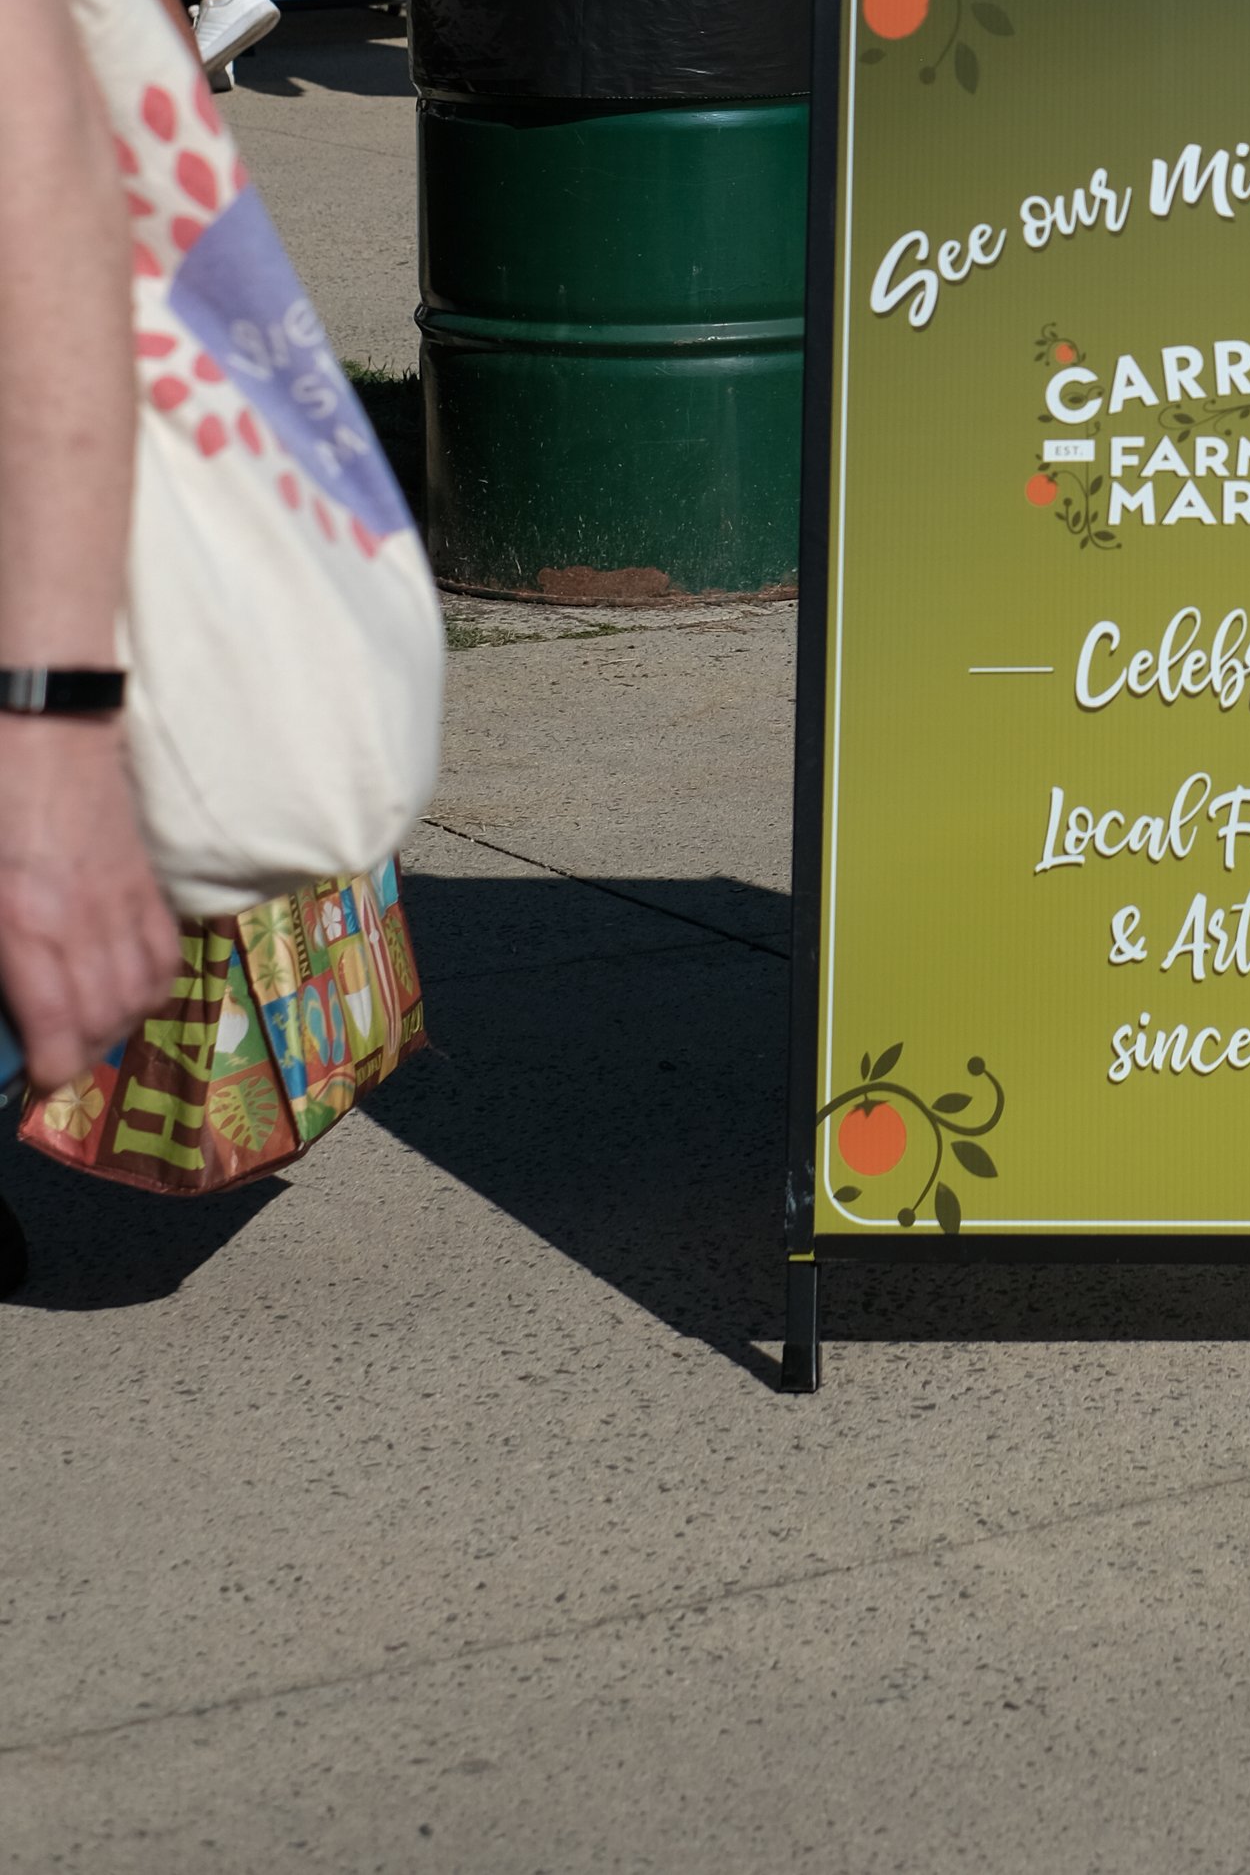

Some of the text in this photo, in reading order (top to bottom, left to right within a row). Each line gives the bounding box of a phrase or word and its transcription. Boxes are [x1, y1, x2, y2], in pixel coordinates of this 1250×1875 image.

[869, 228, 1006, 329] See
[1020, 166, 1131, 249] our
[1034, 771, 1212, 873] Local
[1107, 904, 1147, 963] &
